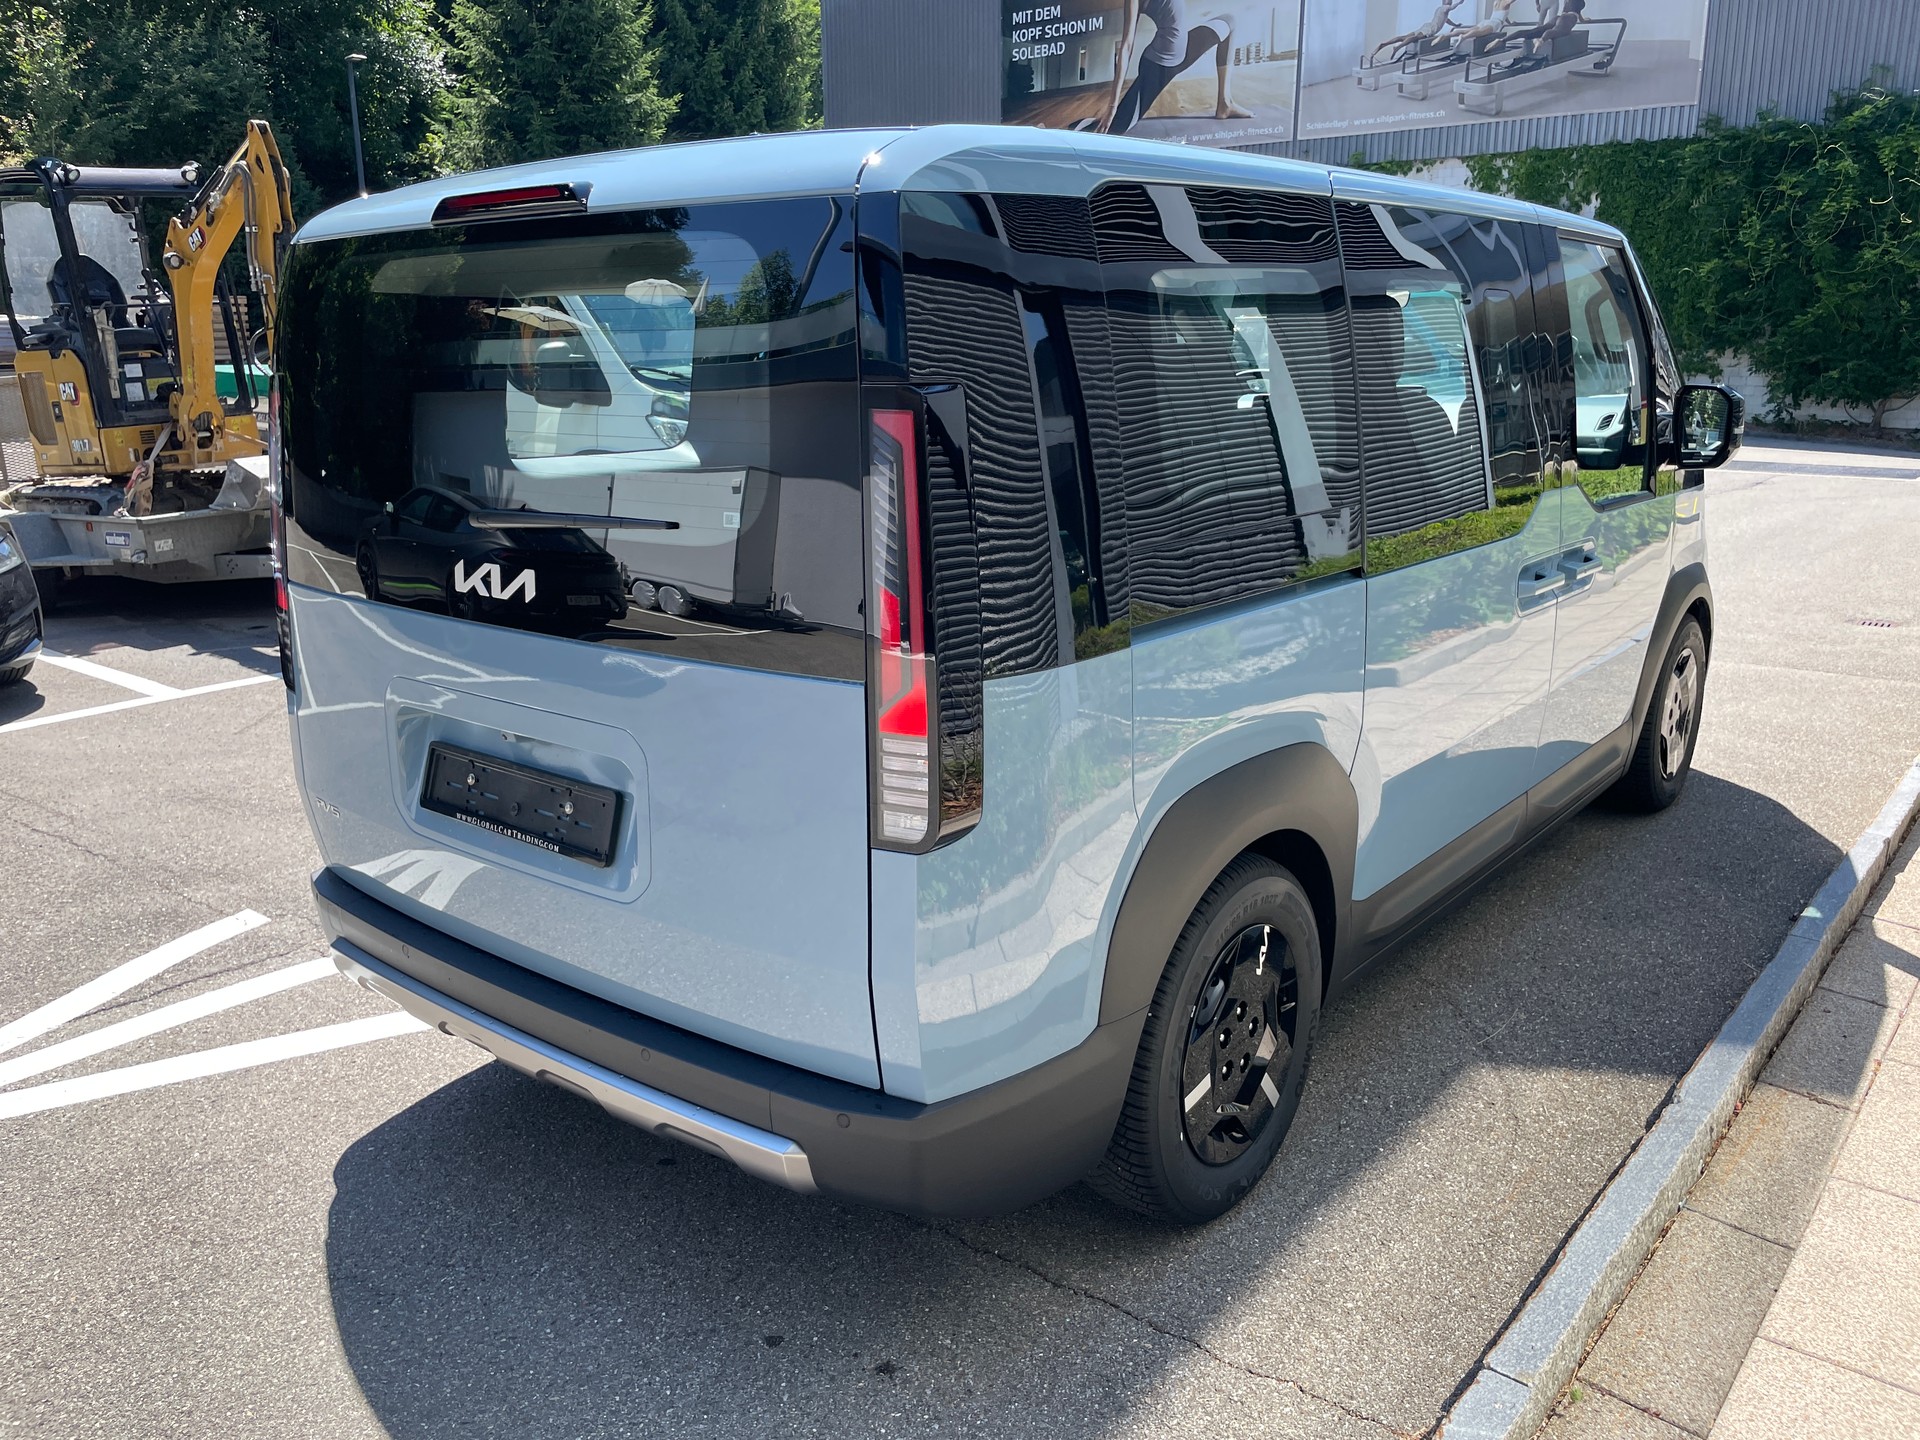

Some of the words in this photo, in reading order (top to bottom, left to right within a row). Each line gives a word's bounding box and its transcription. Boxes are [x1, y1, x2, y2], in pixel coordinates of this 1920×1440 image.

[1012, 10, 1033, 25] MIT
[1035, 5, 1061, 21] DEM
[1012, 27, 1043, 43] KOPF
[1044, 19, 1086, 38] SCHON
[1088, 16, 1103, 31] IM
[1012, 42, 1065, 61] SOLEBAD
[1306, 120, 1349, 130] Schindellegi
[1353, 109, 1446, 125] www.sihlpark-fitness.ch
[1192, 125, 1284, 142] www.sihlpark-fitness.ch
[188, 227, 203, 252] CAT
[59, 382, 76, 401] CAT
[454, 558, 536, 604] KIA
[315, 796, 341, 819] PV5
